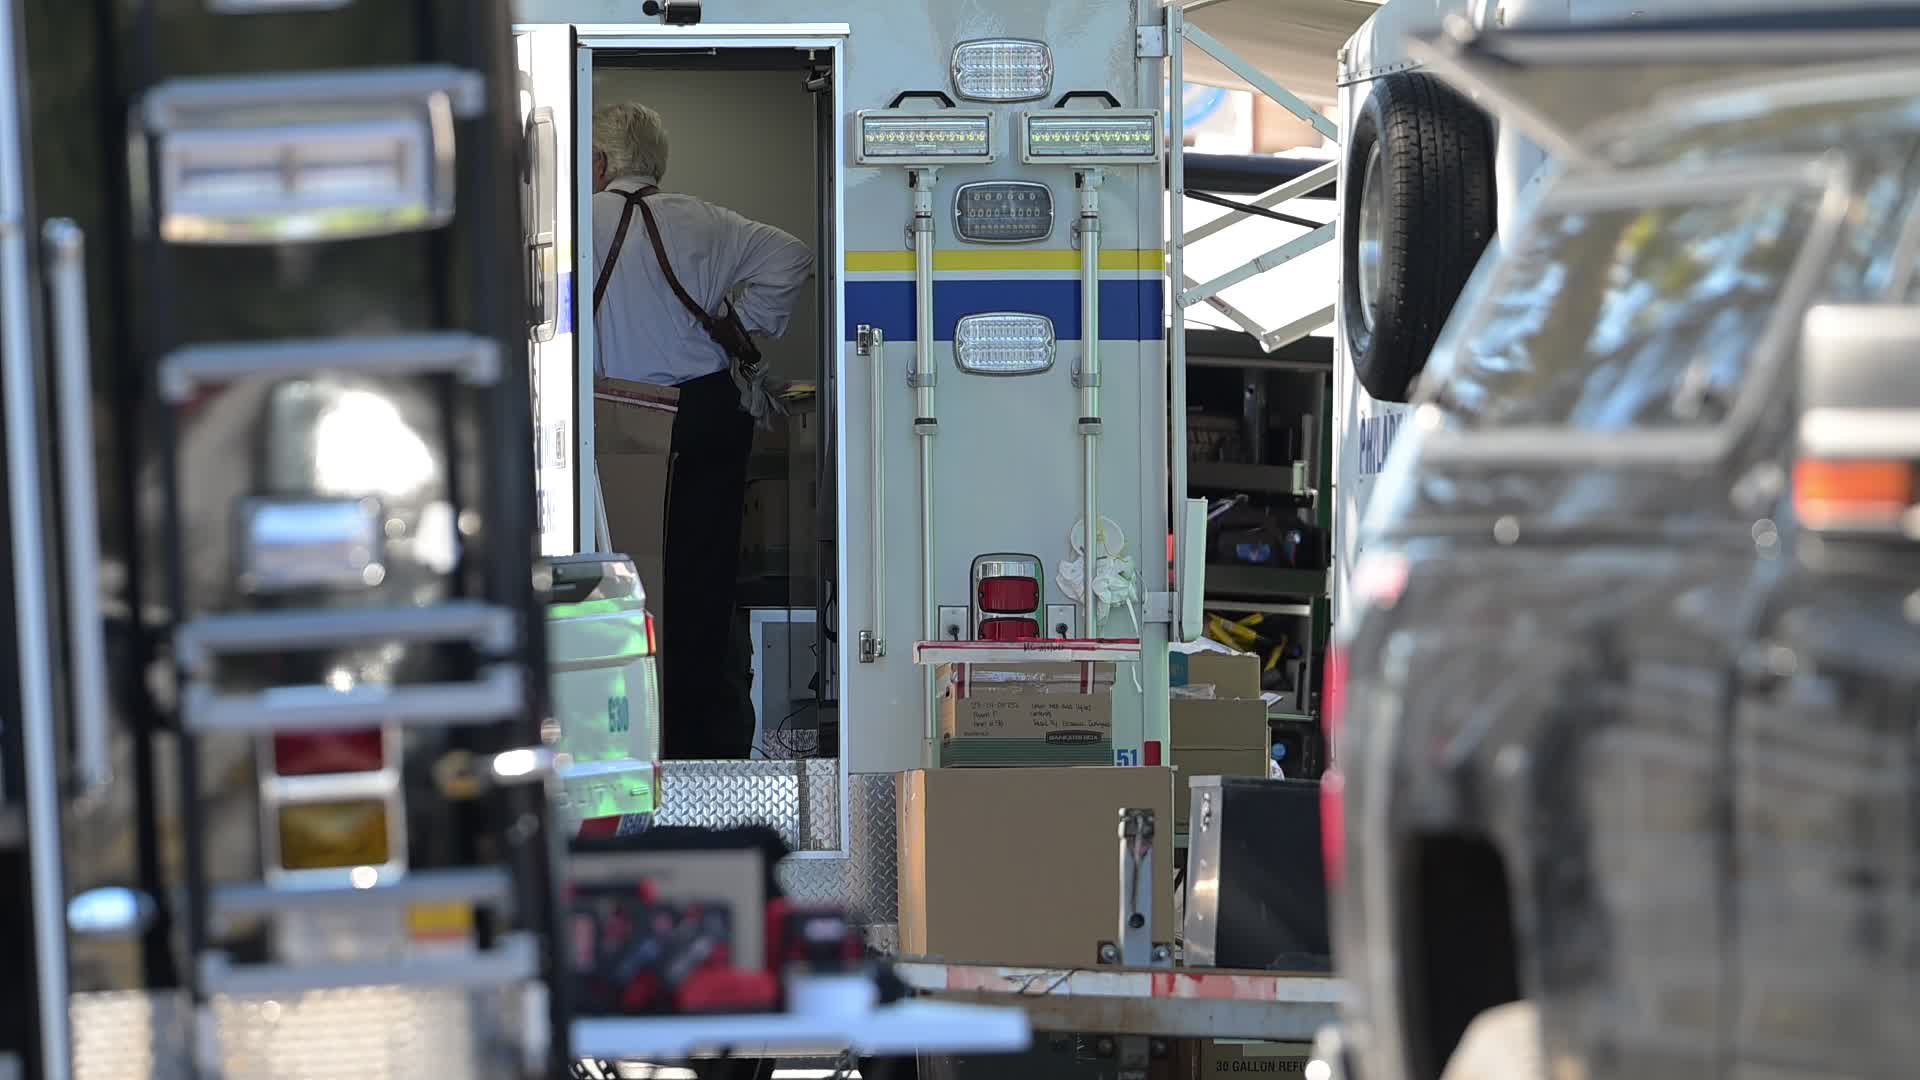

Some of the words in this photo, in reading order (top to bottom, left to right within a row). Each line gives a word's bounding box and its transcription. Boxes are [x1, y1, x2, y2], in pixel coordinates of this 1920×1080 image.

[1116, 748, 1138, 766] 51
[1216, 1061, 1228, 1072] 30
[1232, 1061, 1275, 1072] GALLON
[1279, 1061, 1307, 1072] REFU
